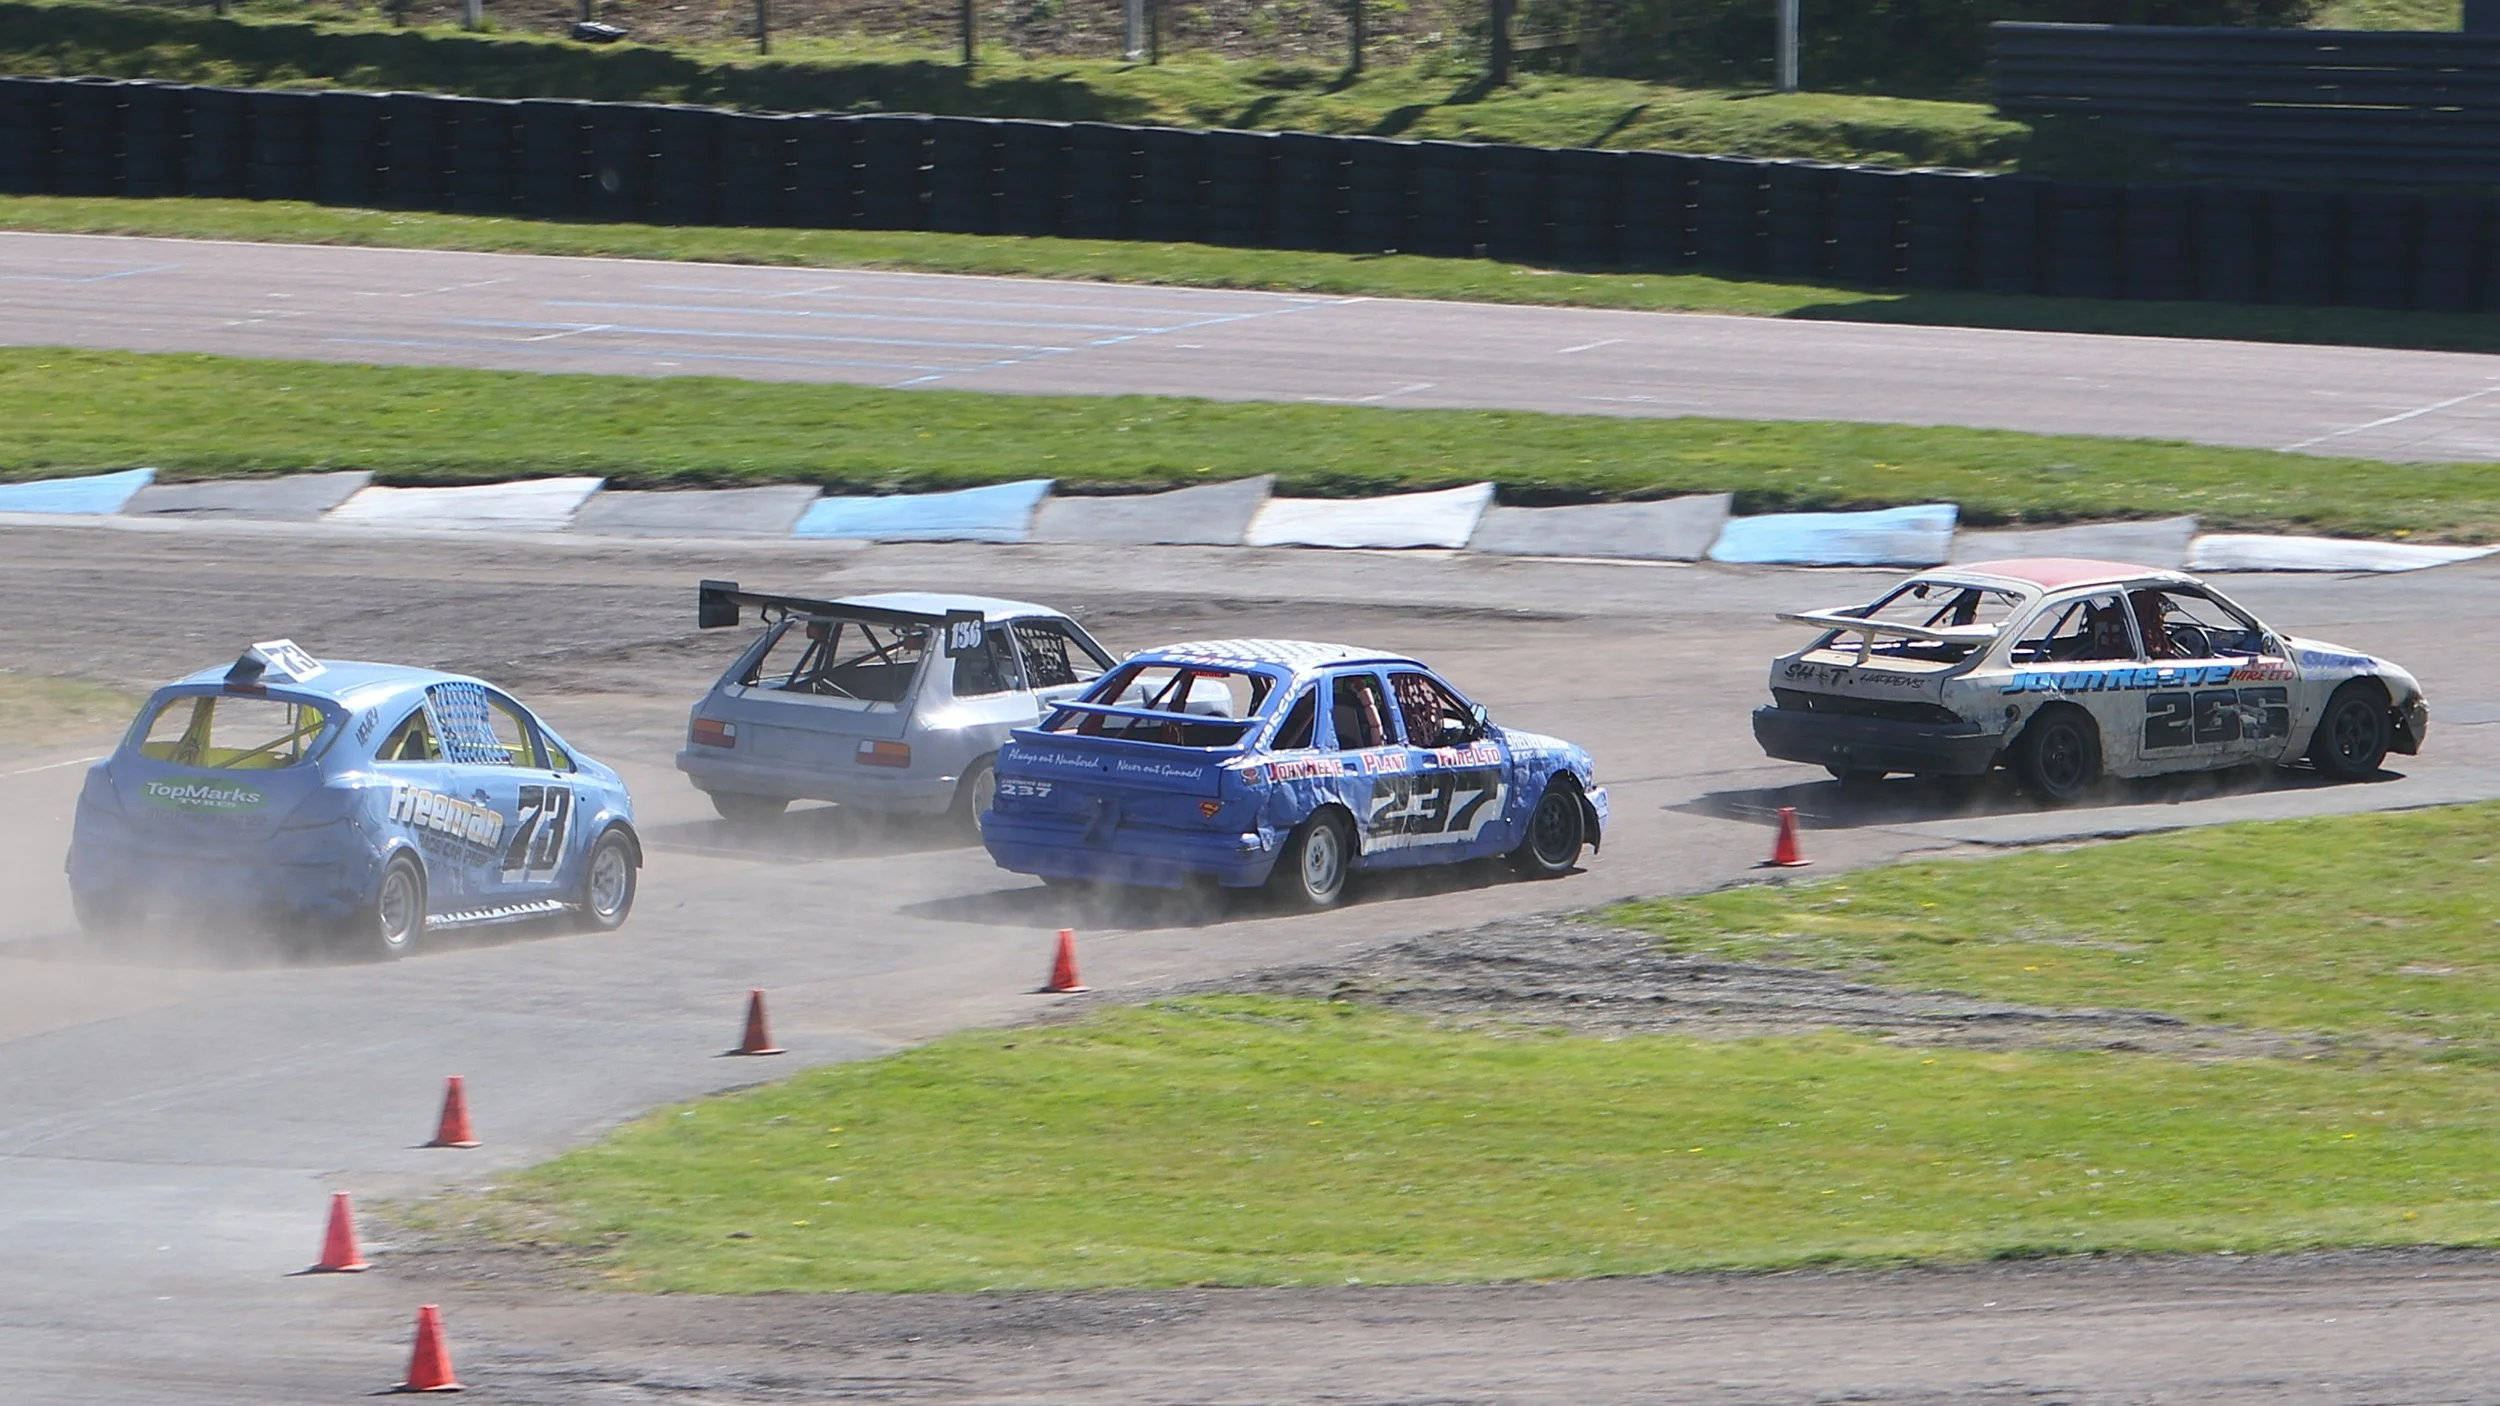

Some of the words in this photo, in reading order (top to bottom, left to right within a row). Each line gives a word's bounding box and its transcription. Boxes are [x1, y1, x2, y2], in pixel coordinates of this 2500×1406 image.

[951, 619, 982, 649] 136
[262, 644, 319, 675] 73
[2231, 669, 2265, 681] HIRE
[2268, 669, 2294, 681] LTD
[1859, 673, 1925, 689] HAPPENS
[1254, 671, 1302, 752] MARCUS
[1008, 748, 1037, 765] Always
[1038, 753, 1054, 763] out
[1054, 753, 1100, 768] Numbered
[1116, 760, 1141, 771] Never
[1143, 764, 1160, 774] out
[1161, 764, 1203, 780] Gunned!
[1361, 752, 1407, 775] PLANT
[1472, 742, 1501, 766] LTD
[147, 782, 260, 803] TopMarks
[1001, 784, 1052, 797] 237
[388, 779, 504, 848] Freeman
[1365, 769, 1505, 846] 237
[502, 784, 574, 880] 73
